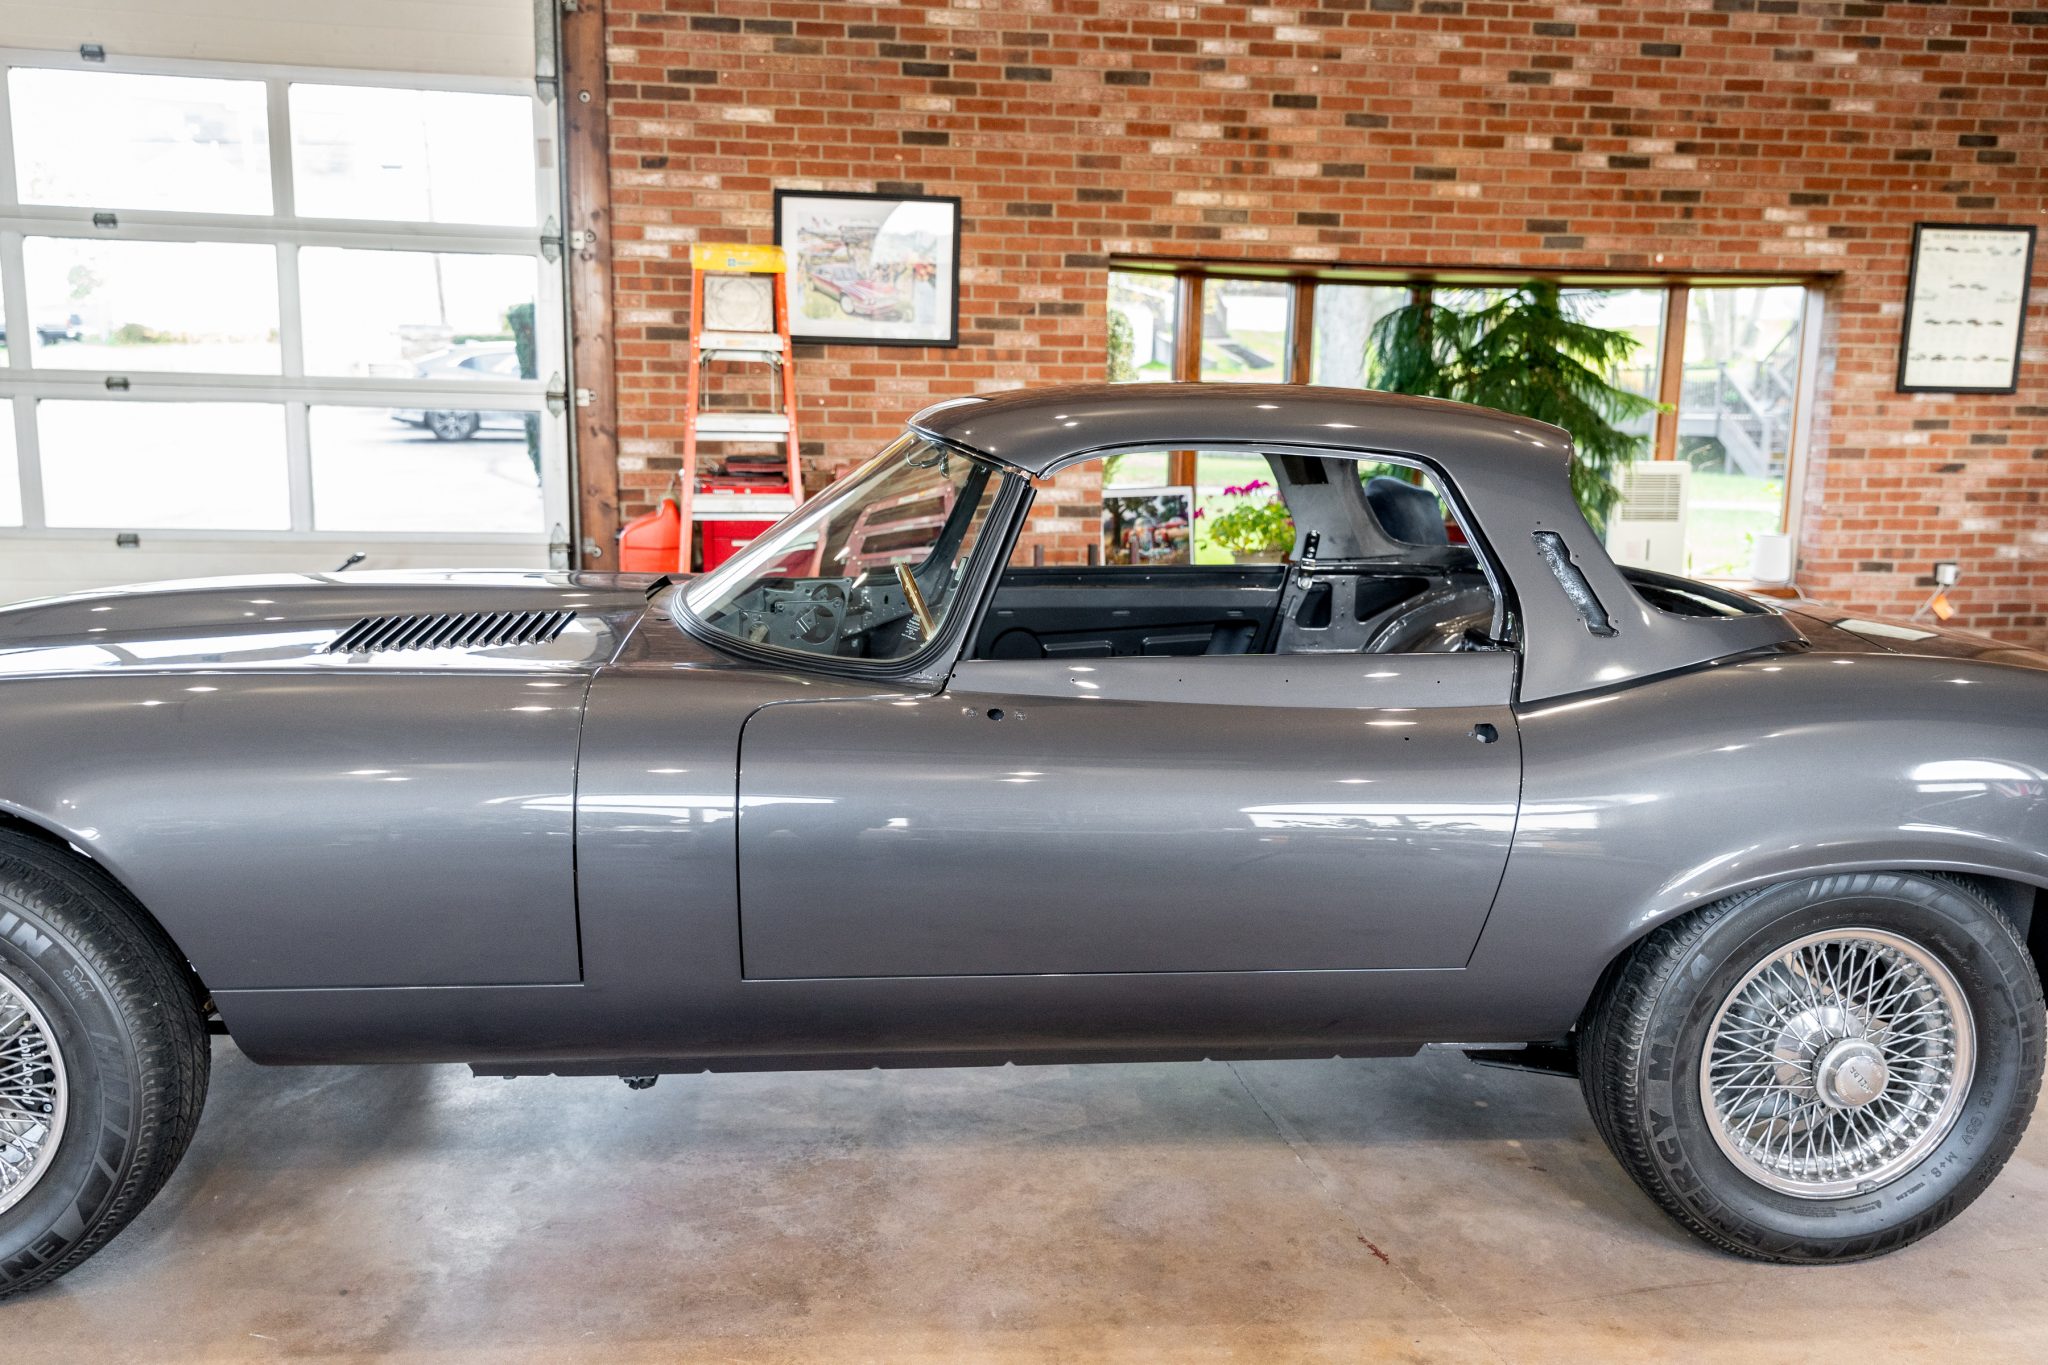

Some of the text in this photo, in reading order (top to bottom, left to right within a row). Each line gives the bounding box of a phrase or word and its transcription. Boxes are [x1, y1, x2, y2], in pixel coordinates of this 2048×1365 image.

[63, 969, 89, 1000] GREEN
[1648, 1107, 1762, 1246] ENERGY
[1931, 1151, 1958, 1178] M+S
